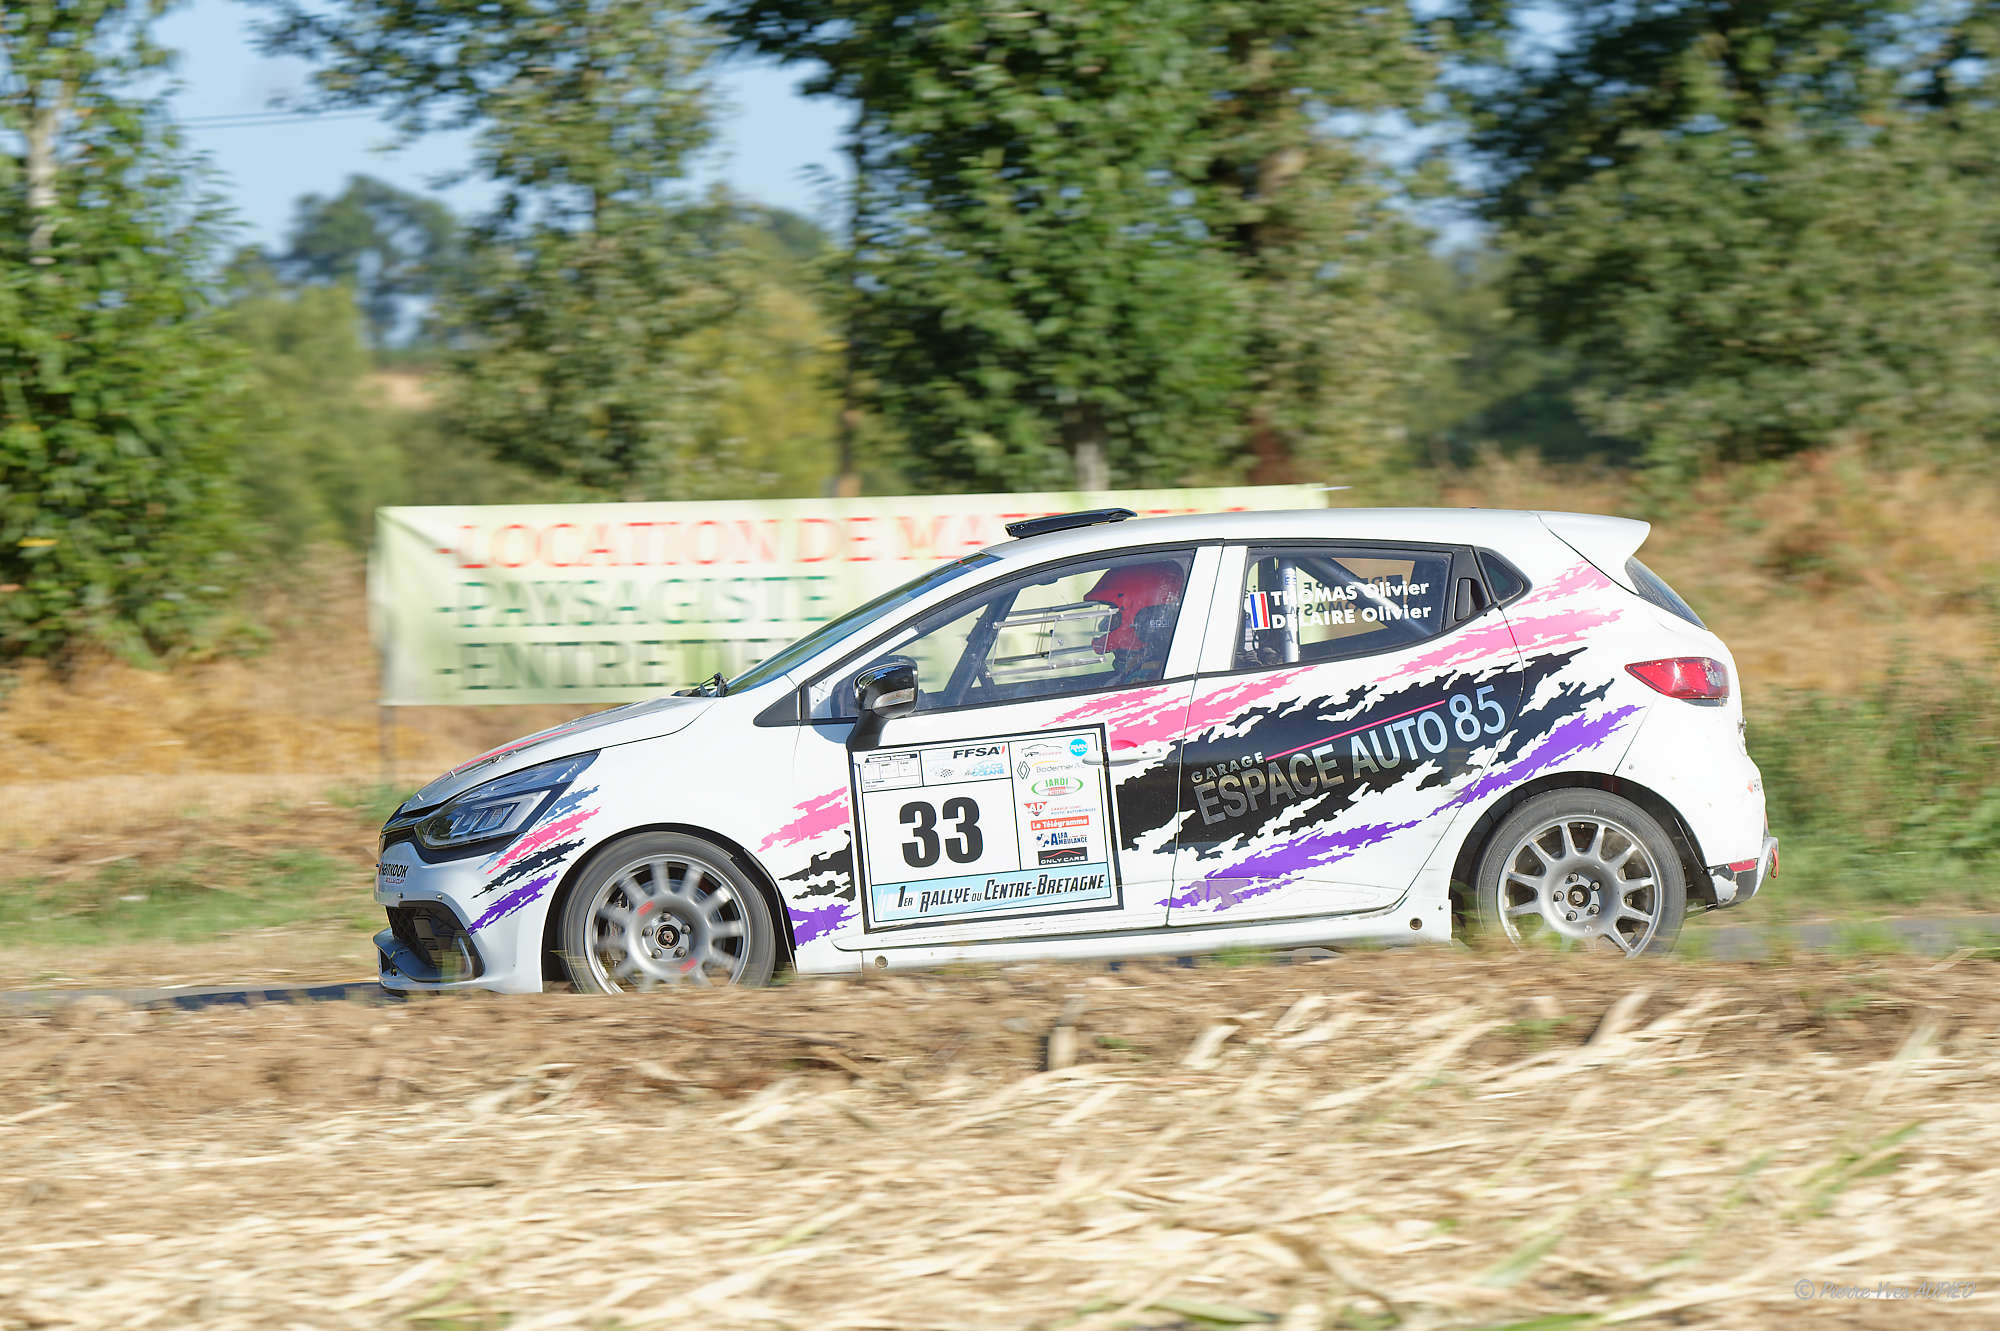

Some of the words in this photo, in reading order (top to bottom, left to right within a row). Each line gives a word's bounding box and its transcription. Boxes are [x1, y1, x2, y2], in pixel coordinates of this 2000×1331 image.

[795, 516, 874, 564] DE
[1364, 580, 1430, 599] Olivier
[1361, 604, 1432, 622] Olivier
[953, 746, 1000, 759] FFSA
[1191, 751, 1264, 783] GARAGE
[1194, 744, 1344, 825] ESPACE
[1350, 711, 1448, 779] AUTO
[1449, 685, 1506, 742] 85
[899, 796, 984, 868] 33
[919, 886, 971, 913] RALLYE
[984, 868, 1105, 901] CENTRE-BRETAGNE
